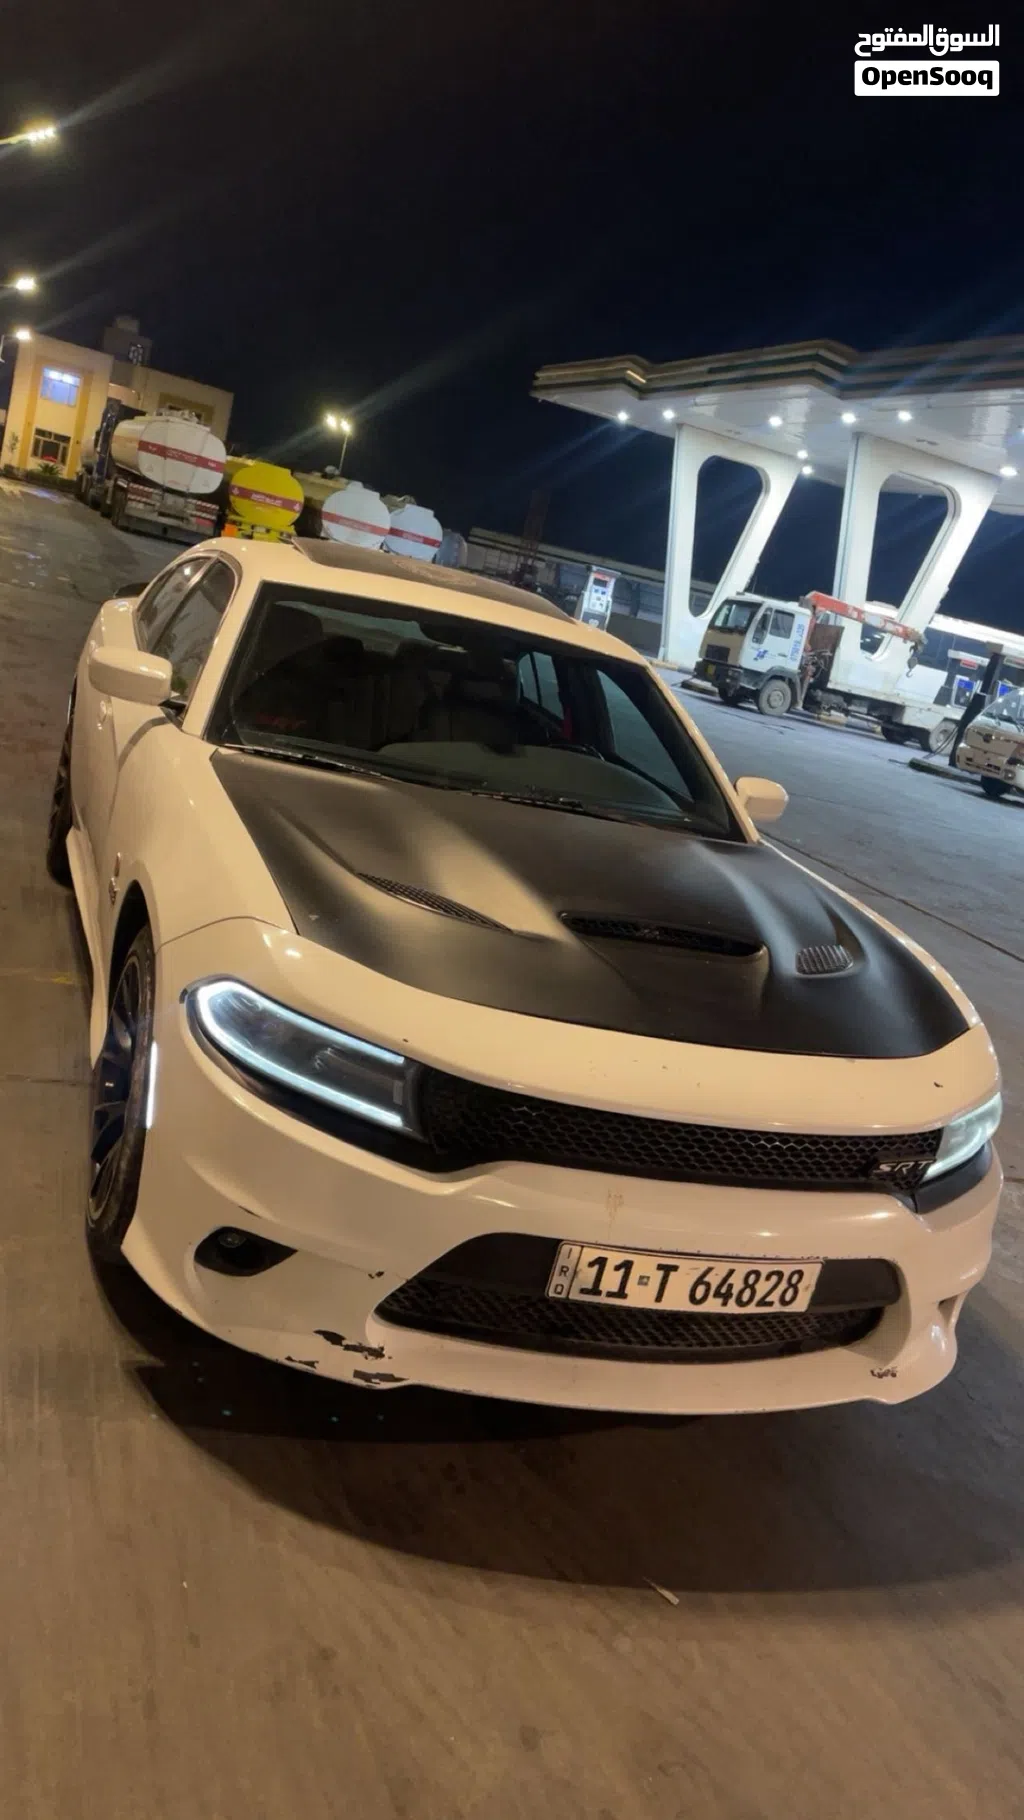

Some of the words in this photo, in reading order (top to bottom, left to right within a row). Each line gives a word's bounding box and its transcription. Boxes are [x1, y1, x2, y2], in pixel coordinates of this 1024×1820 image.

[873, 1160, 934, 1175] SRT
[579, 1256, 634, 1299] 11
[654, 1263, 680, 1303] T
[688, 1266, 804, 1308] 64828
